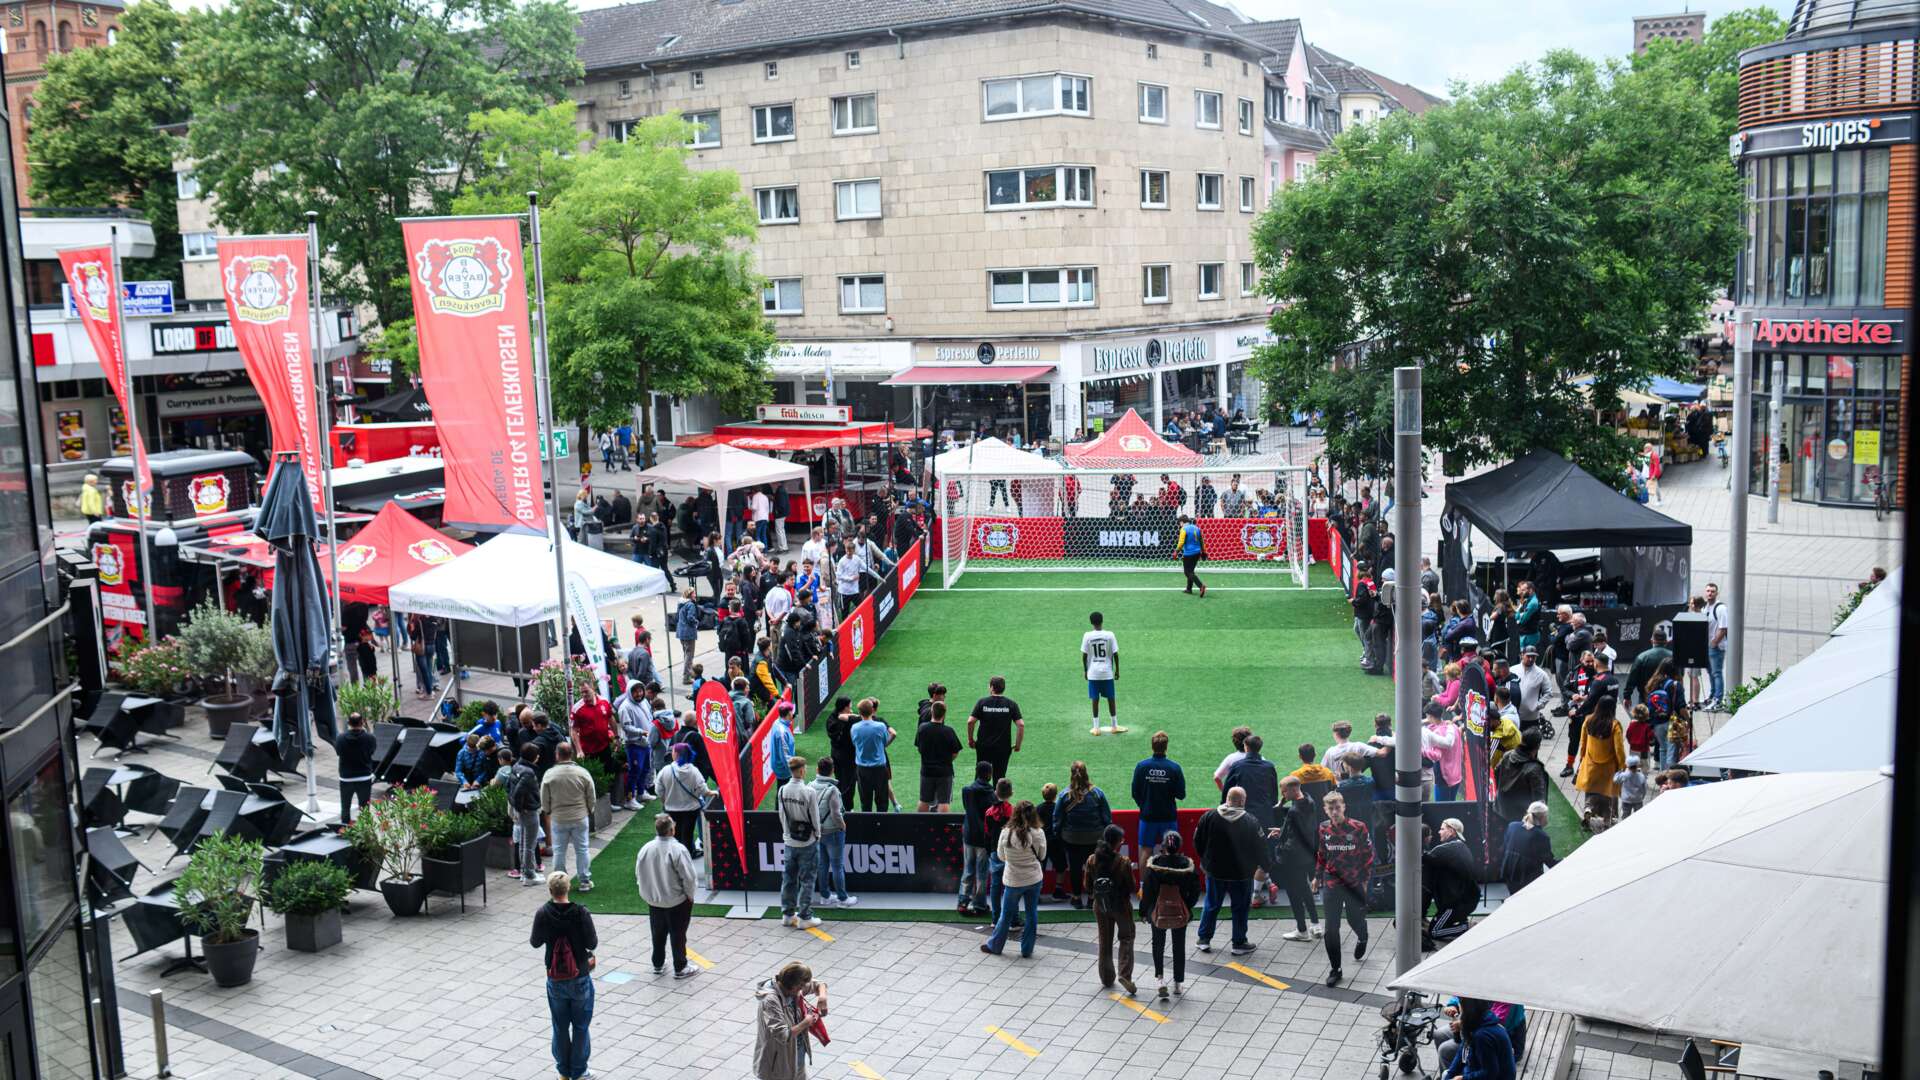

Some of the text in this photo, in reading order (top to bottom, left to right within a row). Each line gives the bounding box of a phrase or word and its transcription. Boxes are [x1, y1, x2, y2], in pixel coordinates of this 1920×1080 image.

[1803, 119, 1871, 150] snipes
[154, 327, 196, 352] LORD
[1757, 319, 1892, 347] Apotheke
[935, 346, 976, 361] Espresso
[996, 345, 1040, 360] Perfetto
[1094, 337, 1209, 373] Espresso Perfetto
[166, 397, 216, 408] Currywurst
[1100, 531, 1160, 547] BAYER 04
[1092, 643, 1106, 657] 16
